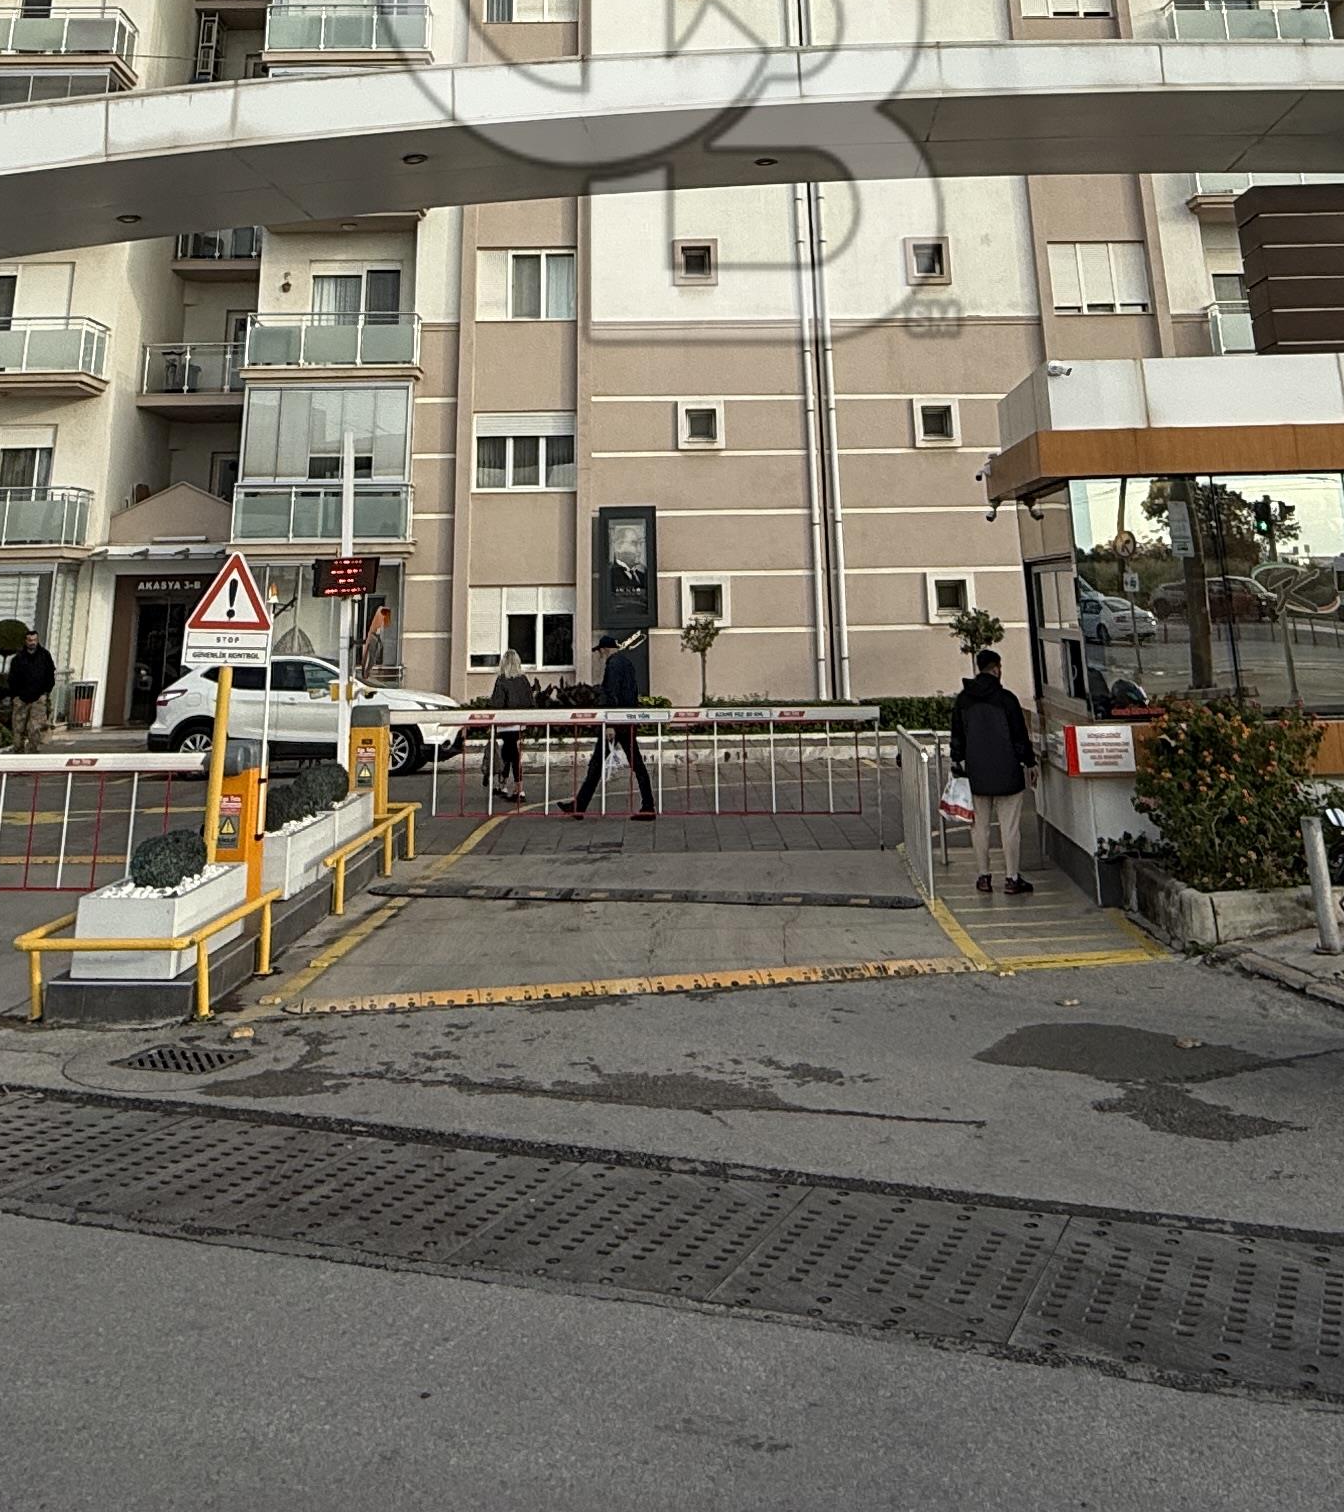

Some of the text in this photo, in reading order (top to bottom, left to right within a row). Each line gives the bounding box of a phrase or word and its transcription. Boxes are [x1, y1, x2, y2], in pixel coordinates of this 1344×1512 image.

[137, 580, 201, 591] AKASYA 3-B
[216, 636, 240, 644] STOP
